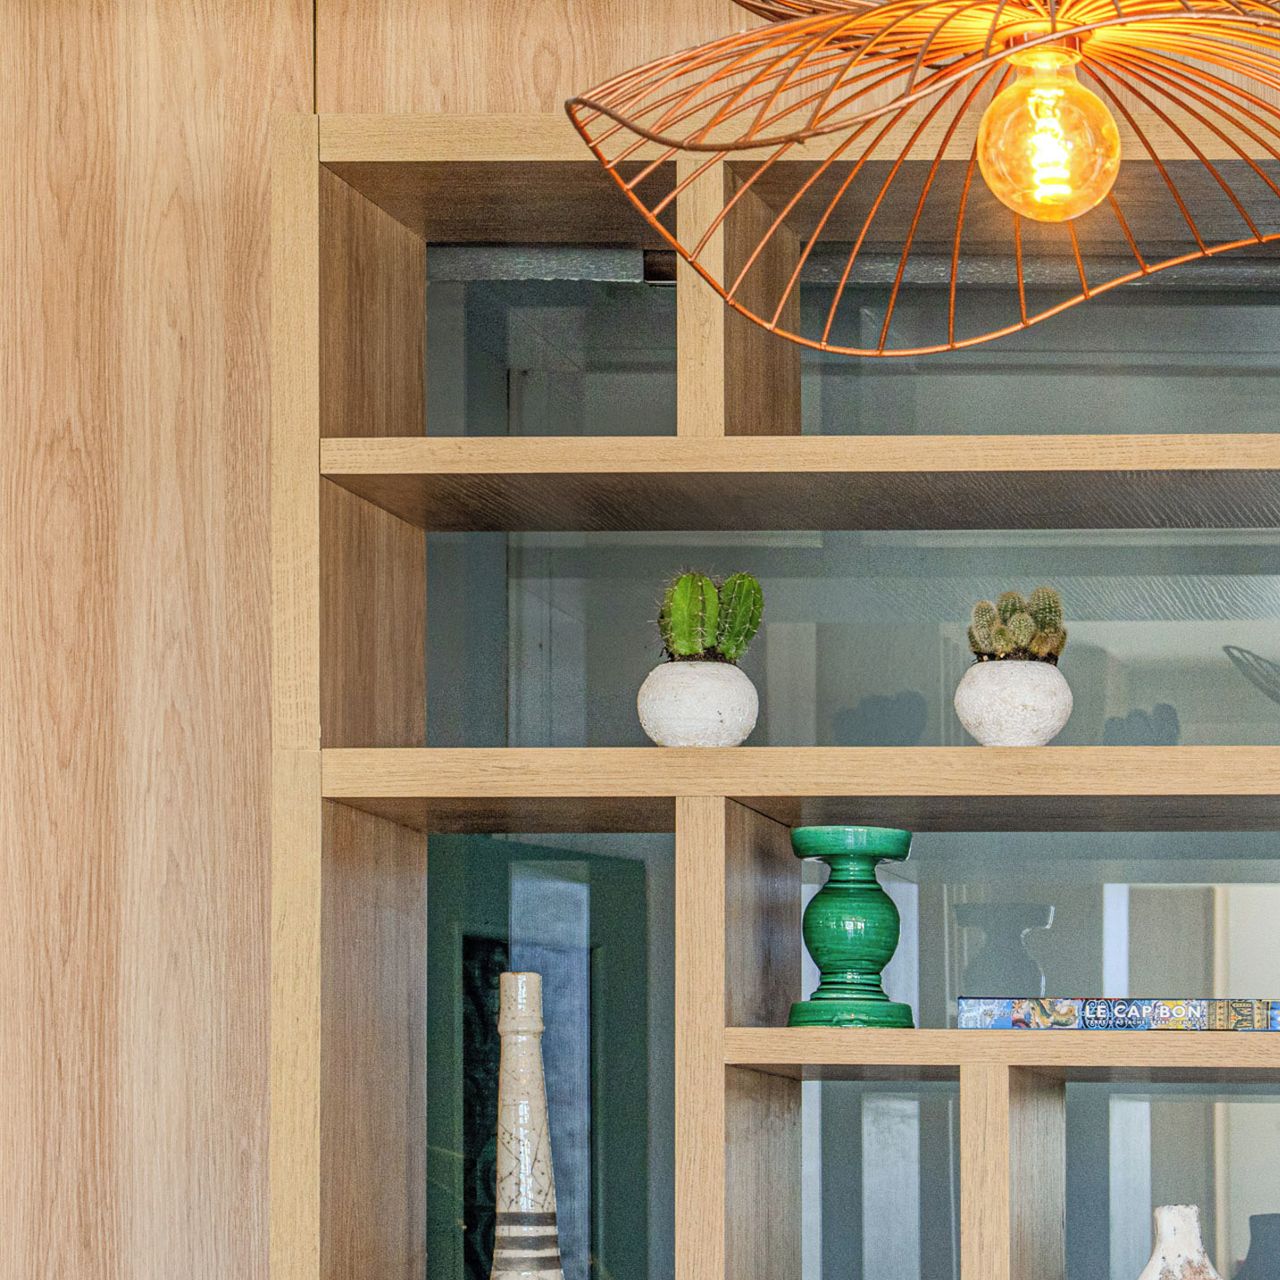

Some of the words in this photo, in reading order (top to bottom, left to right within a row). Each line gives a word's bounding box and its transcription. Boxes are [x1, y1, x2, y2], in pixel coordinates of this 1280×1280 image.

[1086, 1005, 1106, 1018] LE
[1114, 1005, 1152, 1018] CAP
[1160, 1005, 1200, 1018] BON
